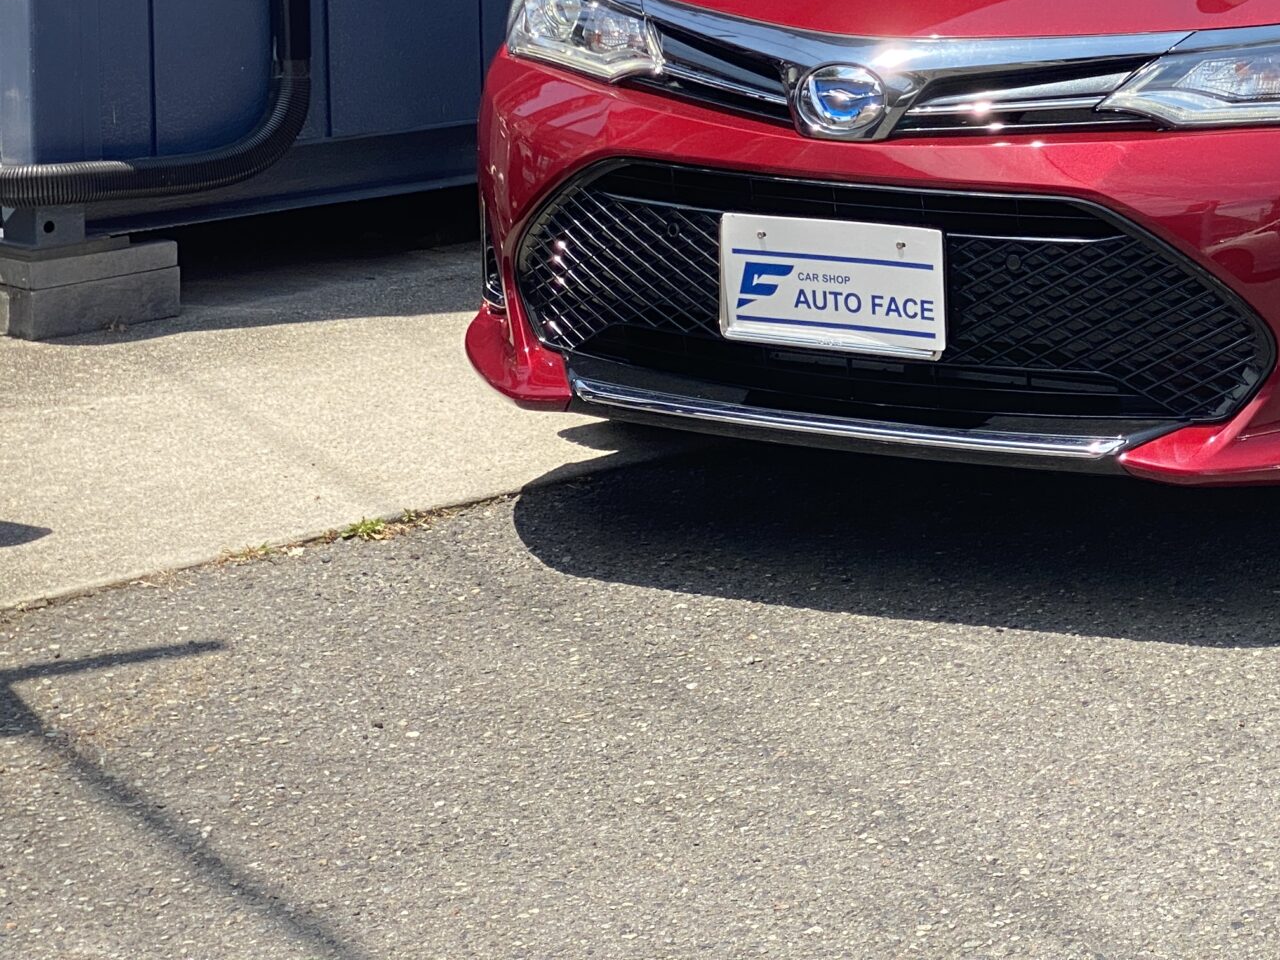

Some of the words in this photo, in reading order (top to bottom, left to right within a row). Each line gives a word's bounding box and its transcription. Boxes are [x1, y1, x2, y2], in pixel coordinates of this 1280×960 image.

[797, 271, 820, 283] CAR
[822, 273, 851, 285] SHOP
[793, 288, 862, 314] AUTO
[870, 294, 935, 321] FACE
